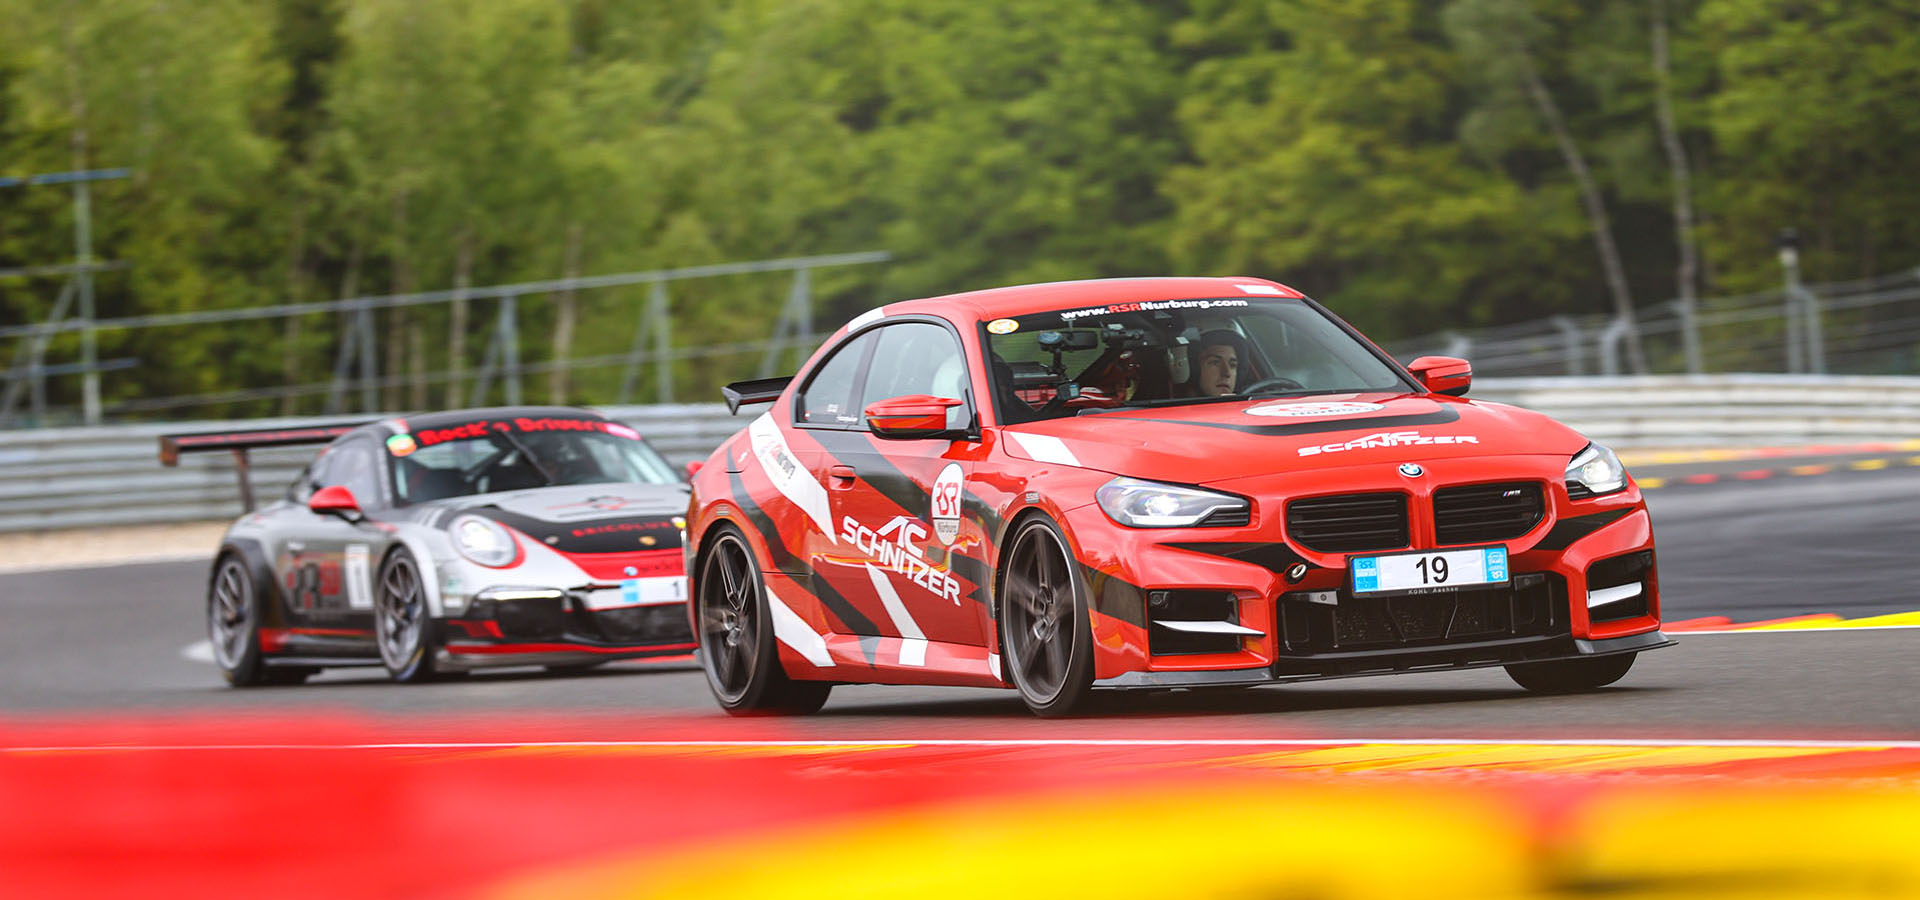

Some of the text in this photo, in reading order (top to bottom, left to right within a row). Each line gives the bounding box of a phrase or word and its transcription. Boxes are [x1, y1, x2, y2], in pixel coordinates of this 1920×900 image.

[1060, 299, 1249, 319] www.RSRNurburg.com
[1297, 435, 1480, 457] SCHNITZER
[877, 515, 927, 558] AC
[841, 515, 961, 607] SCHNITZER
[1415, 556, 1449, 584] 19
[672, 580, 680, 597] 1
